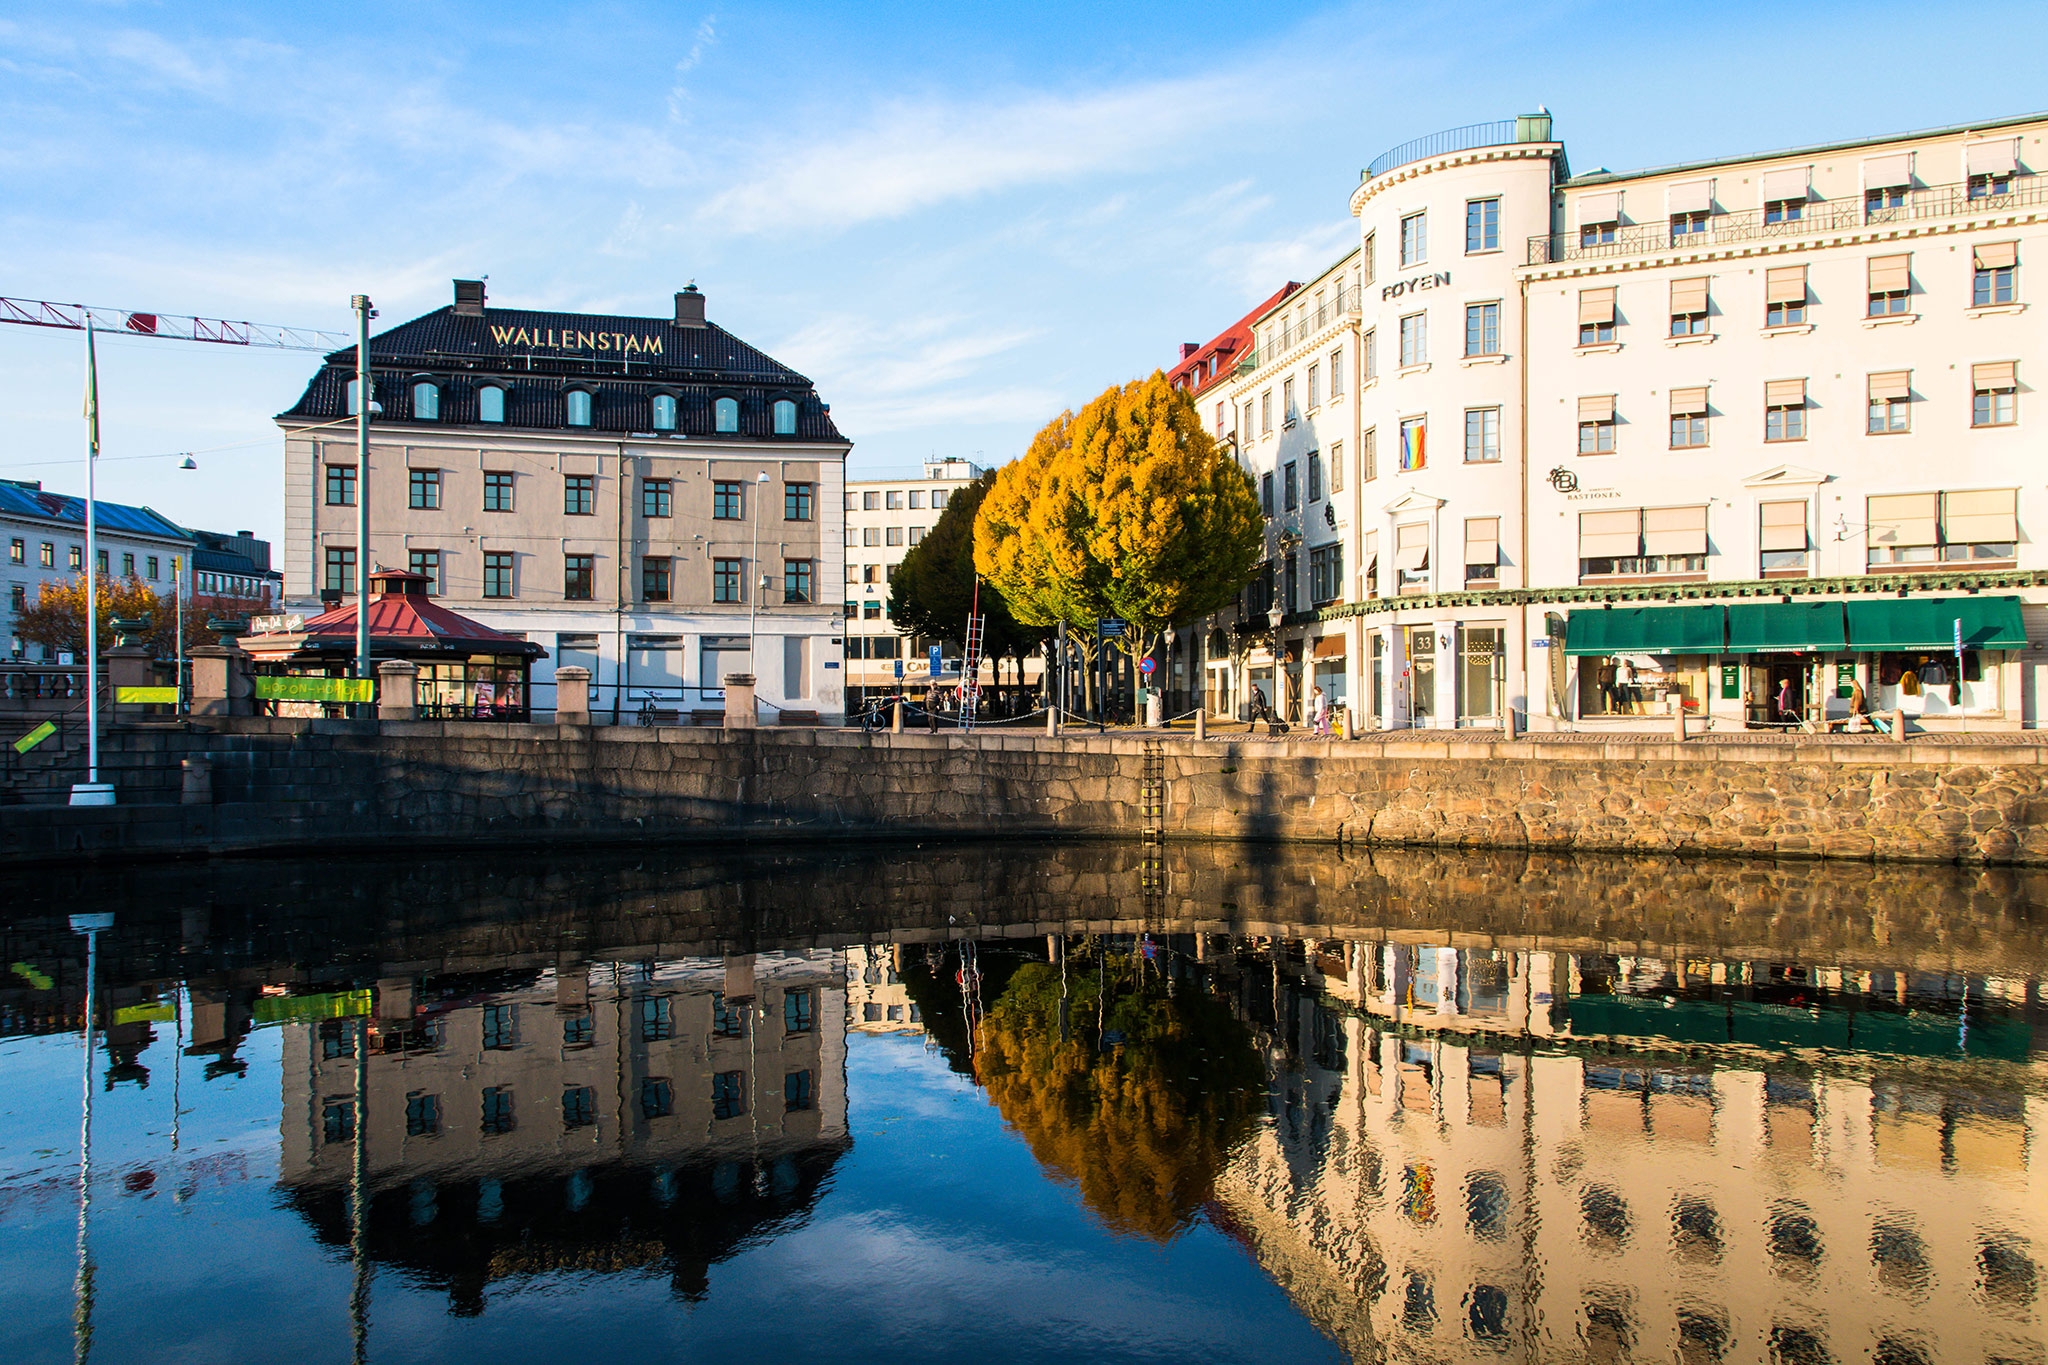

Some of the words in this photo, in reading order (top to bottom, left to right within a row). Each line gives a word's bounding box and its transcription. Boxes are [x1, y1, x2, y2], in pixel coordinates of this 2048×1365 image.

[490, 325, 664, 354] WALLENSTAM
[1567, 491, 1622, 501] BASTIONEN
[1417, 636, 1431, 650] 33
[262, 682, 287, 693] HOP
